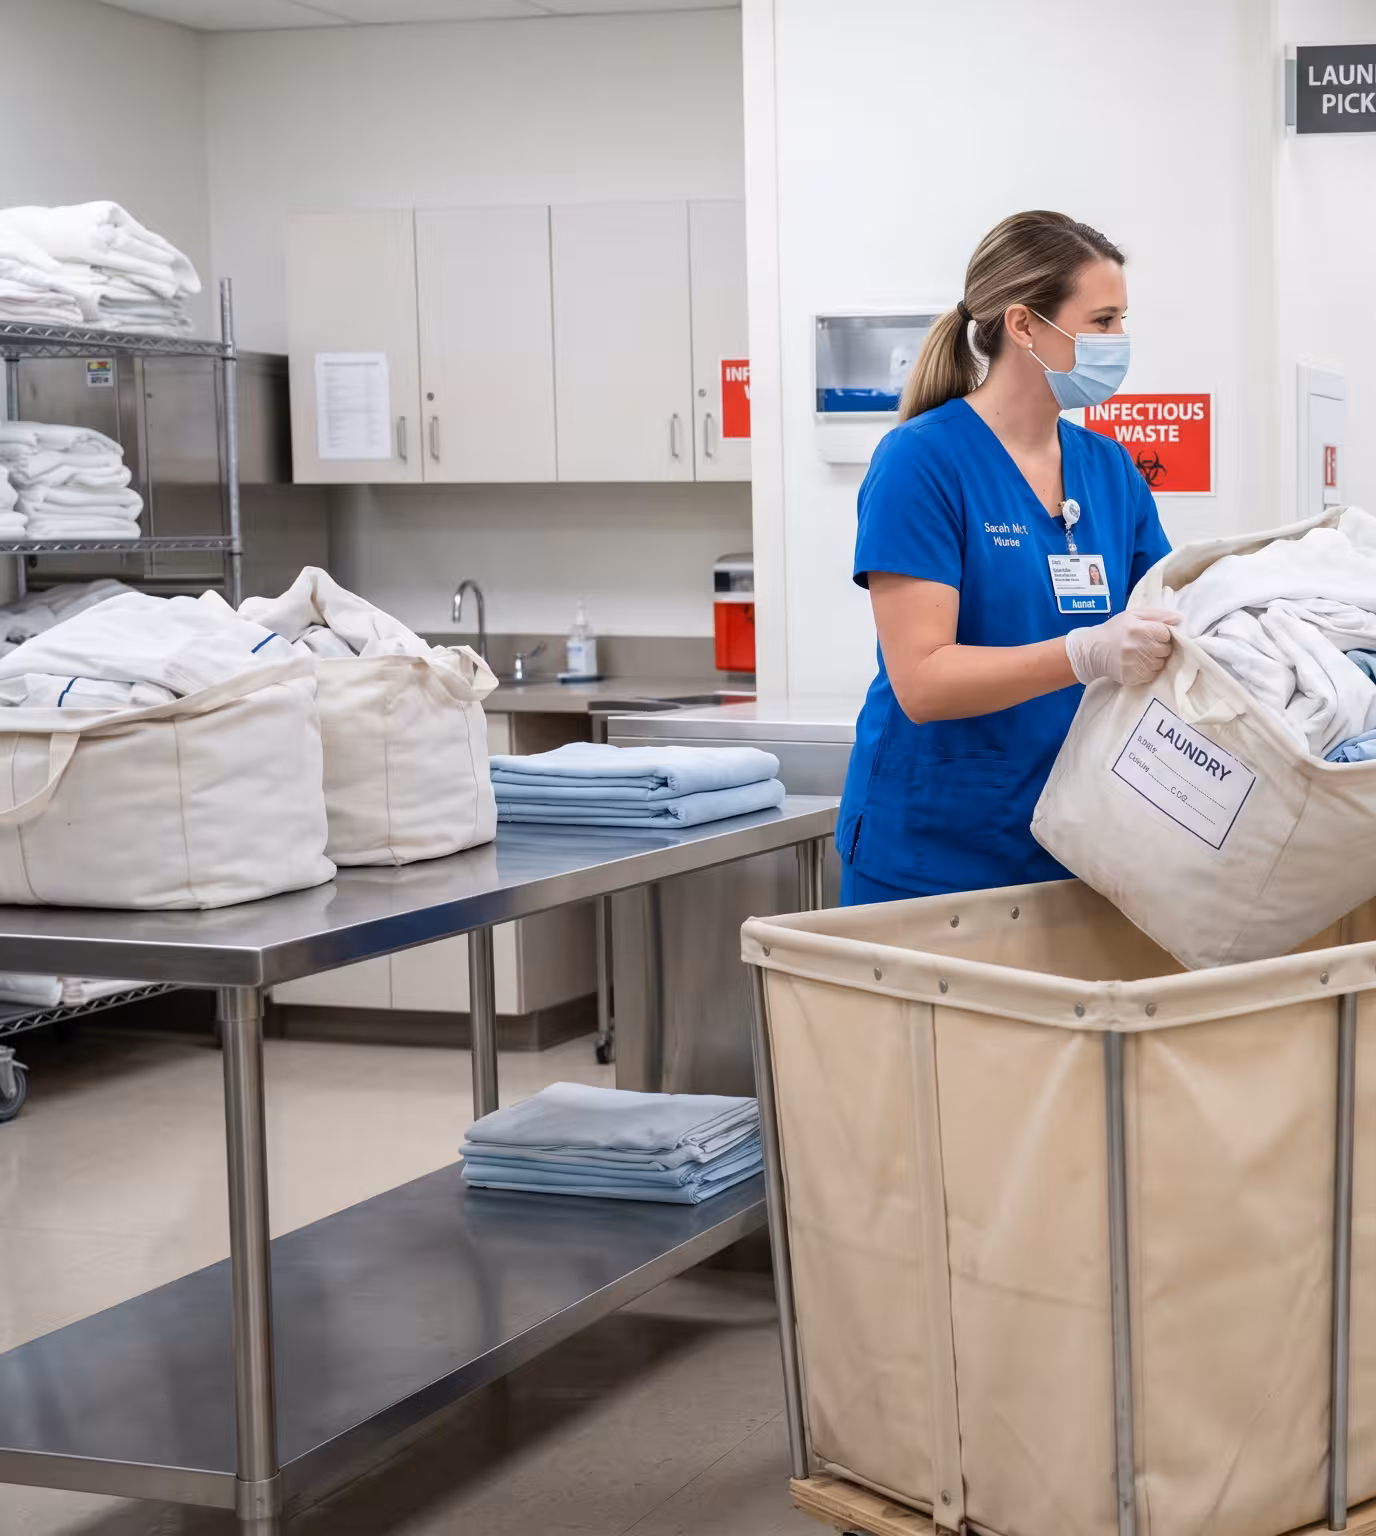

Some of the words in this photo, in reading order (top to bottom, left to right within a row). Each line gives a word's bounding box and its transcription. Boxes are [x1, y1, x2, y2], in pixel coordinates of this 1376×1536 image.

[1089, 402, 1205, 421] INFECTIOUS
[1114, 424, 1180, 443] WASTE
[1155, 719, 1232, 782] LAUNDRY
